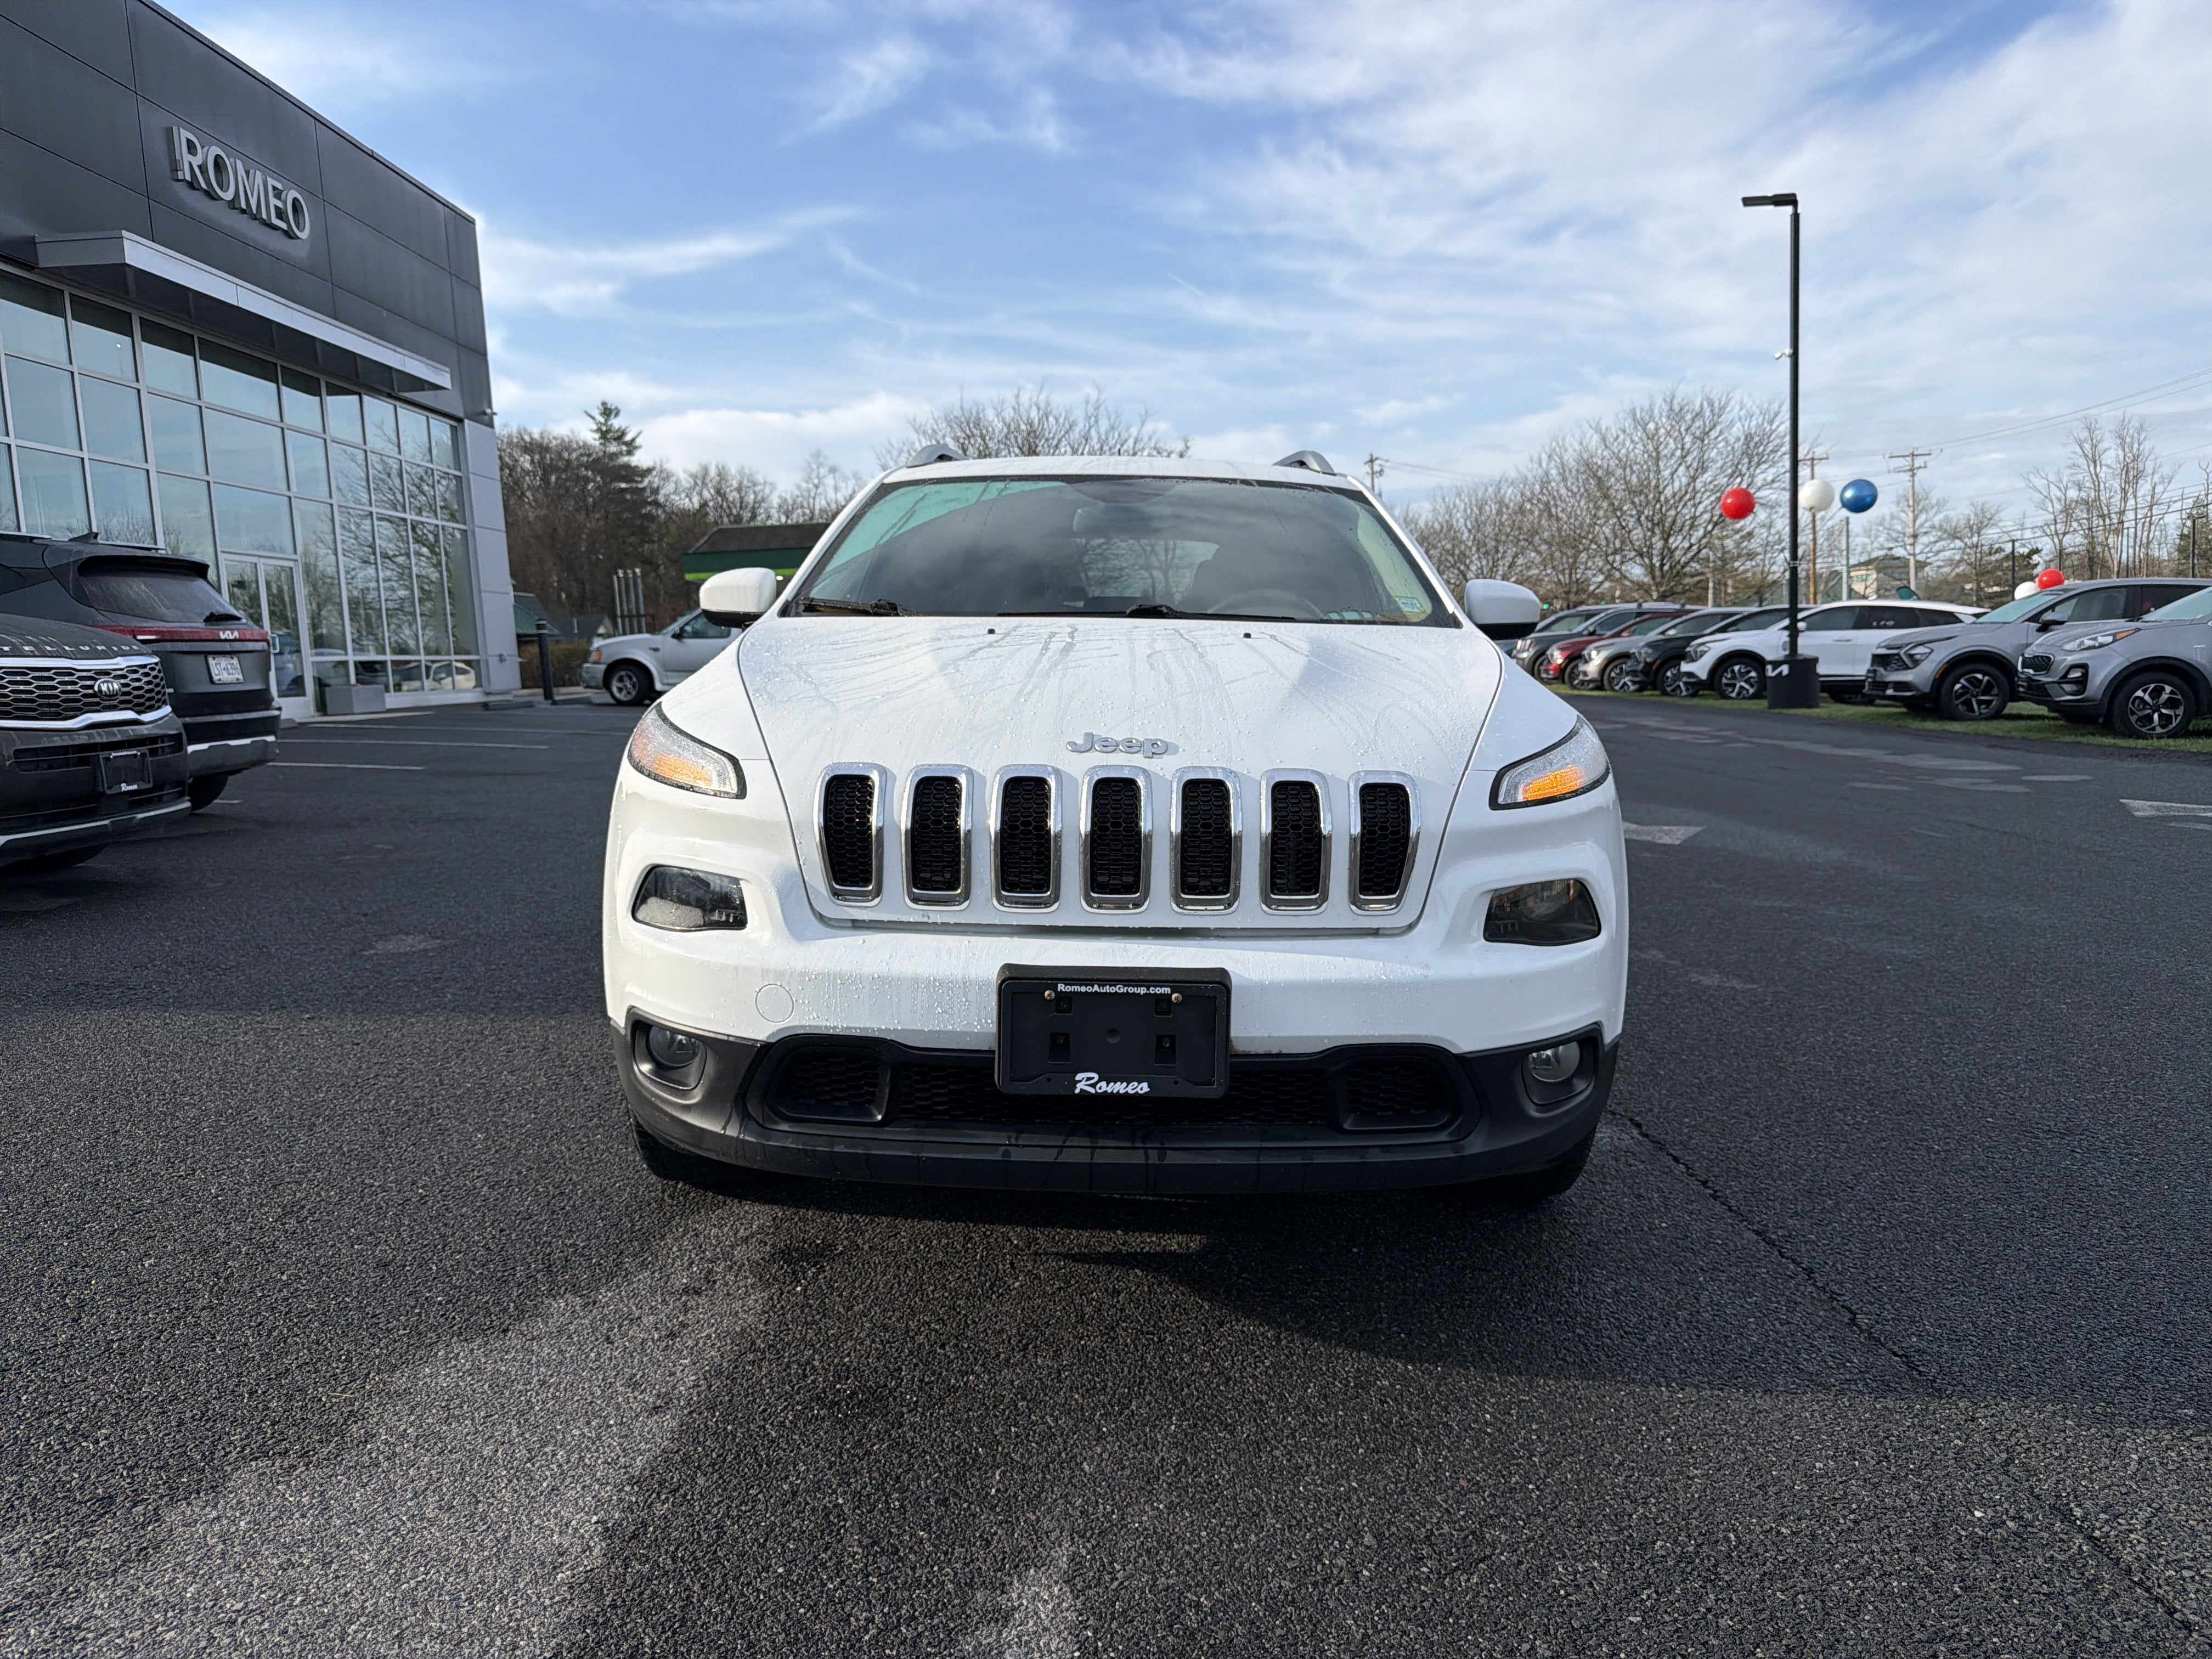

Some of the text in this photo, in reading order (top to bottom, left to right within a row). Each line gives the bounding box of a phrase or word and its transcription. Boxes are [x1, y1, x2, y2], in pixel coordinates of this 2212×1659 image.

[171, 126, 311, 240] ROMEO
[100, 682, 120, 695] KIA
[1066, 732, 1169, 759] Jeep
[1057, 984, 1171, 995] RomeoAutoGroup.com
[1075, 1072, 1150, 1094] Romeo
